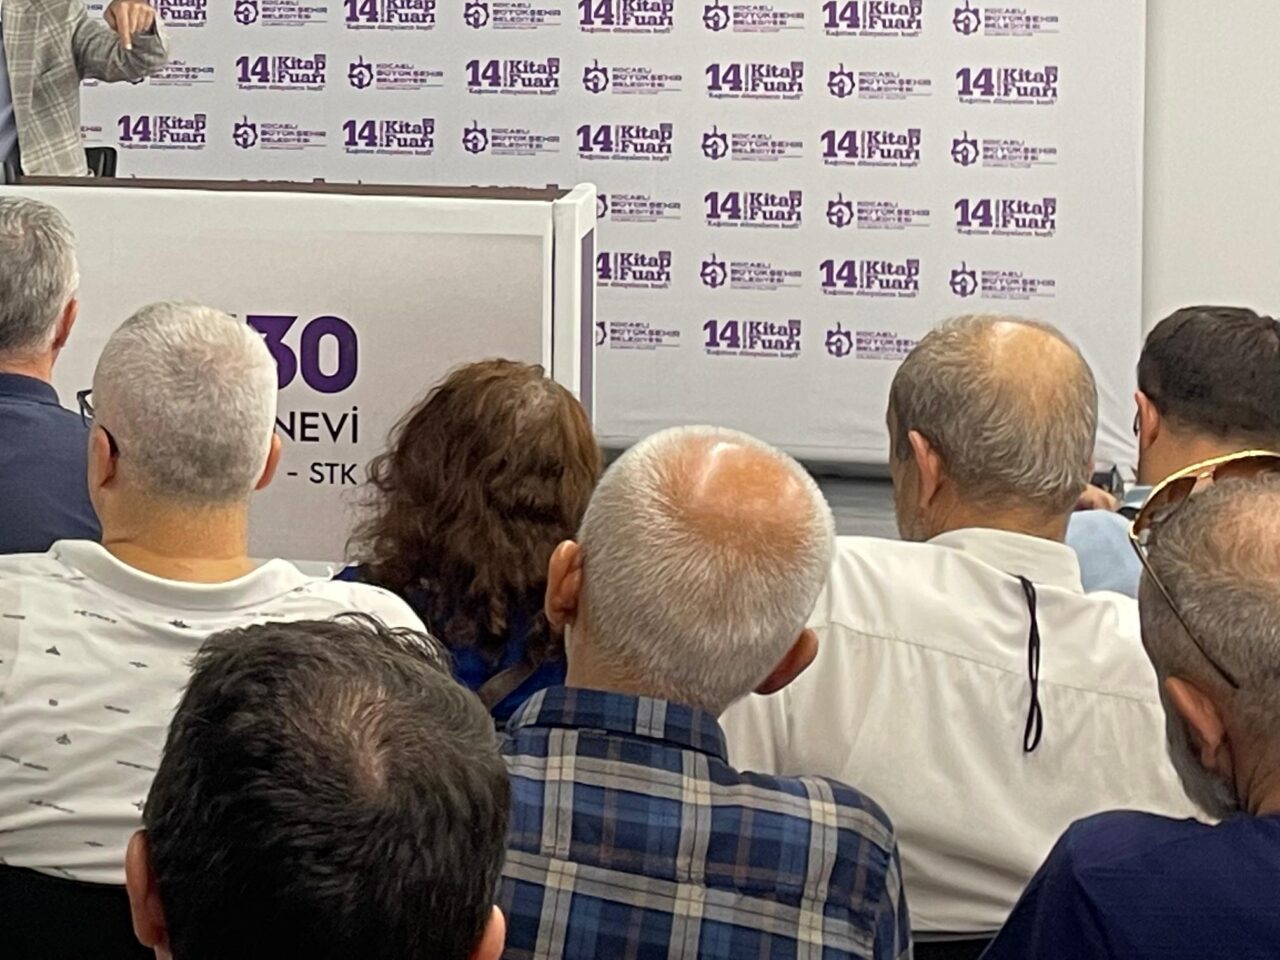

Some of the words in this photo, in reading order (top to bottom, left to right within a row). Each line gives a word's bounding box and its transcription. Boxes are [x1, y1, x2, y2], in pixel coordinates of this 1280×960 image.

[236, 56, 270, 82] 14
[277, 56, 326, 74] Kitap
[750, 64, 804, 82] Kitap
[706, 64, 742, 91] 14
[343, 120, 377, 146] 14
[384, 120, 434, 138] Kitap
[866, 130, 922, 149] Kitap
[821, 130, 858, 158] 14
[955, 199, 993, 227] 14
[1001, 199, 1056, 219] Kitap
[703, 320, 740, 348] 14
[748, 321, 802, 340] Kitap
[246, 315, 358, 394] 30
[309, 462, 357, 485] STK
